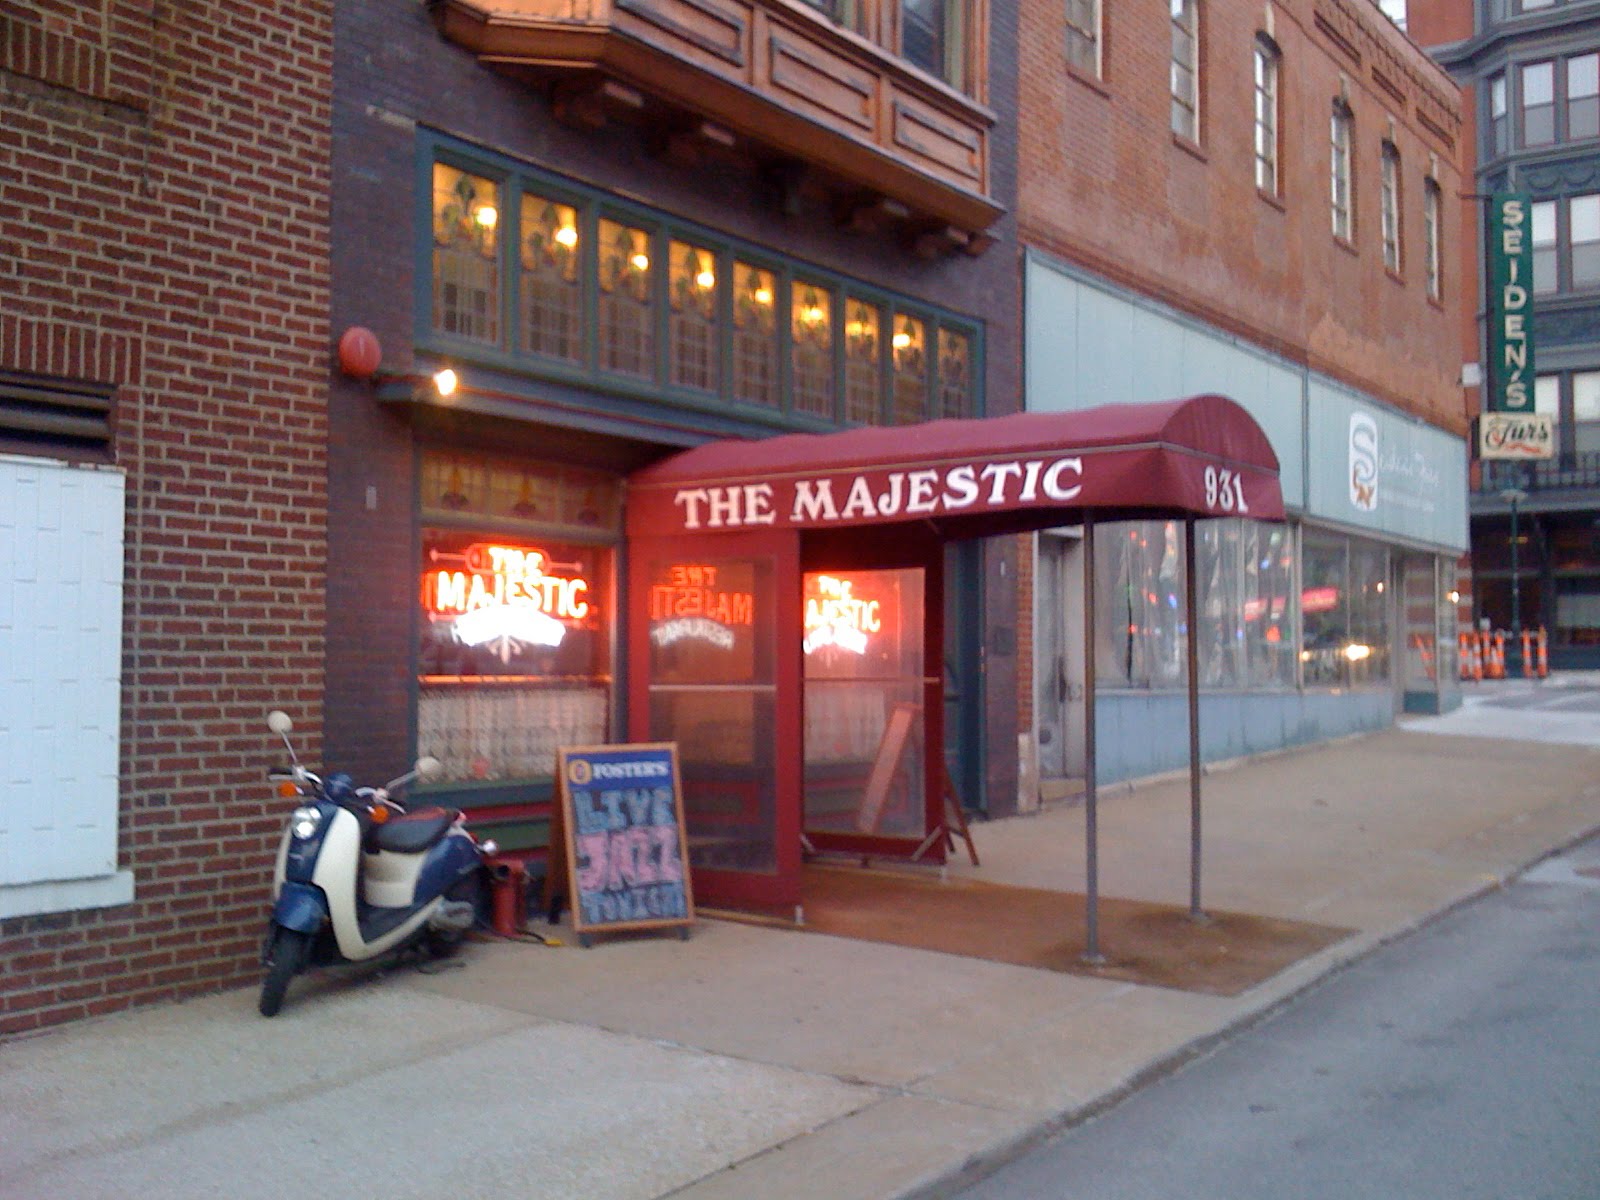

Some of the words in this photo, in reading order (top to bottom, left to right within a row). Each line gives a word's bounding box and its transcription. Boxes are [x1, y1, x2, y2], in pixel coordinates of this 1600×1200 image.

[1502, 200, 1528, 408] SEIDEN'S
[674, 484, 777, 530] THE
[790, 457, 1084, 523] MAJESTIC
[1204, 465, 1249, 513] 931
[488, 546, 543, 577] THE
[437, 570, 589, 618] MAJESTIC
[804, 598, 881, 632] AJESTIC
[573, 786, 676, 834] LIVE
[576, 825, 683, 892] JAZZ
